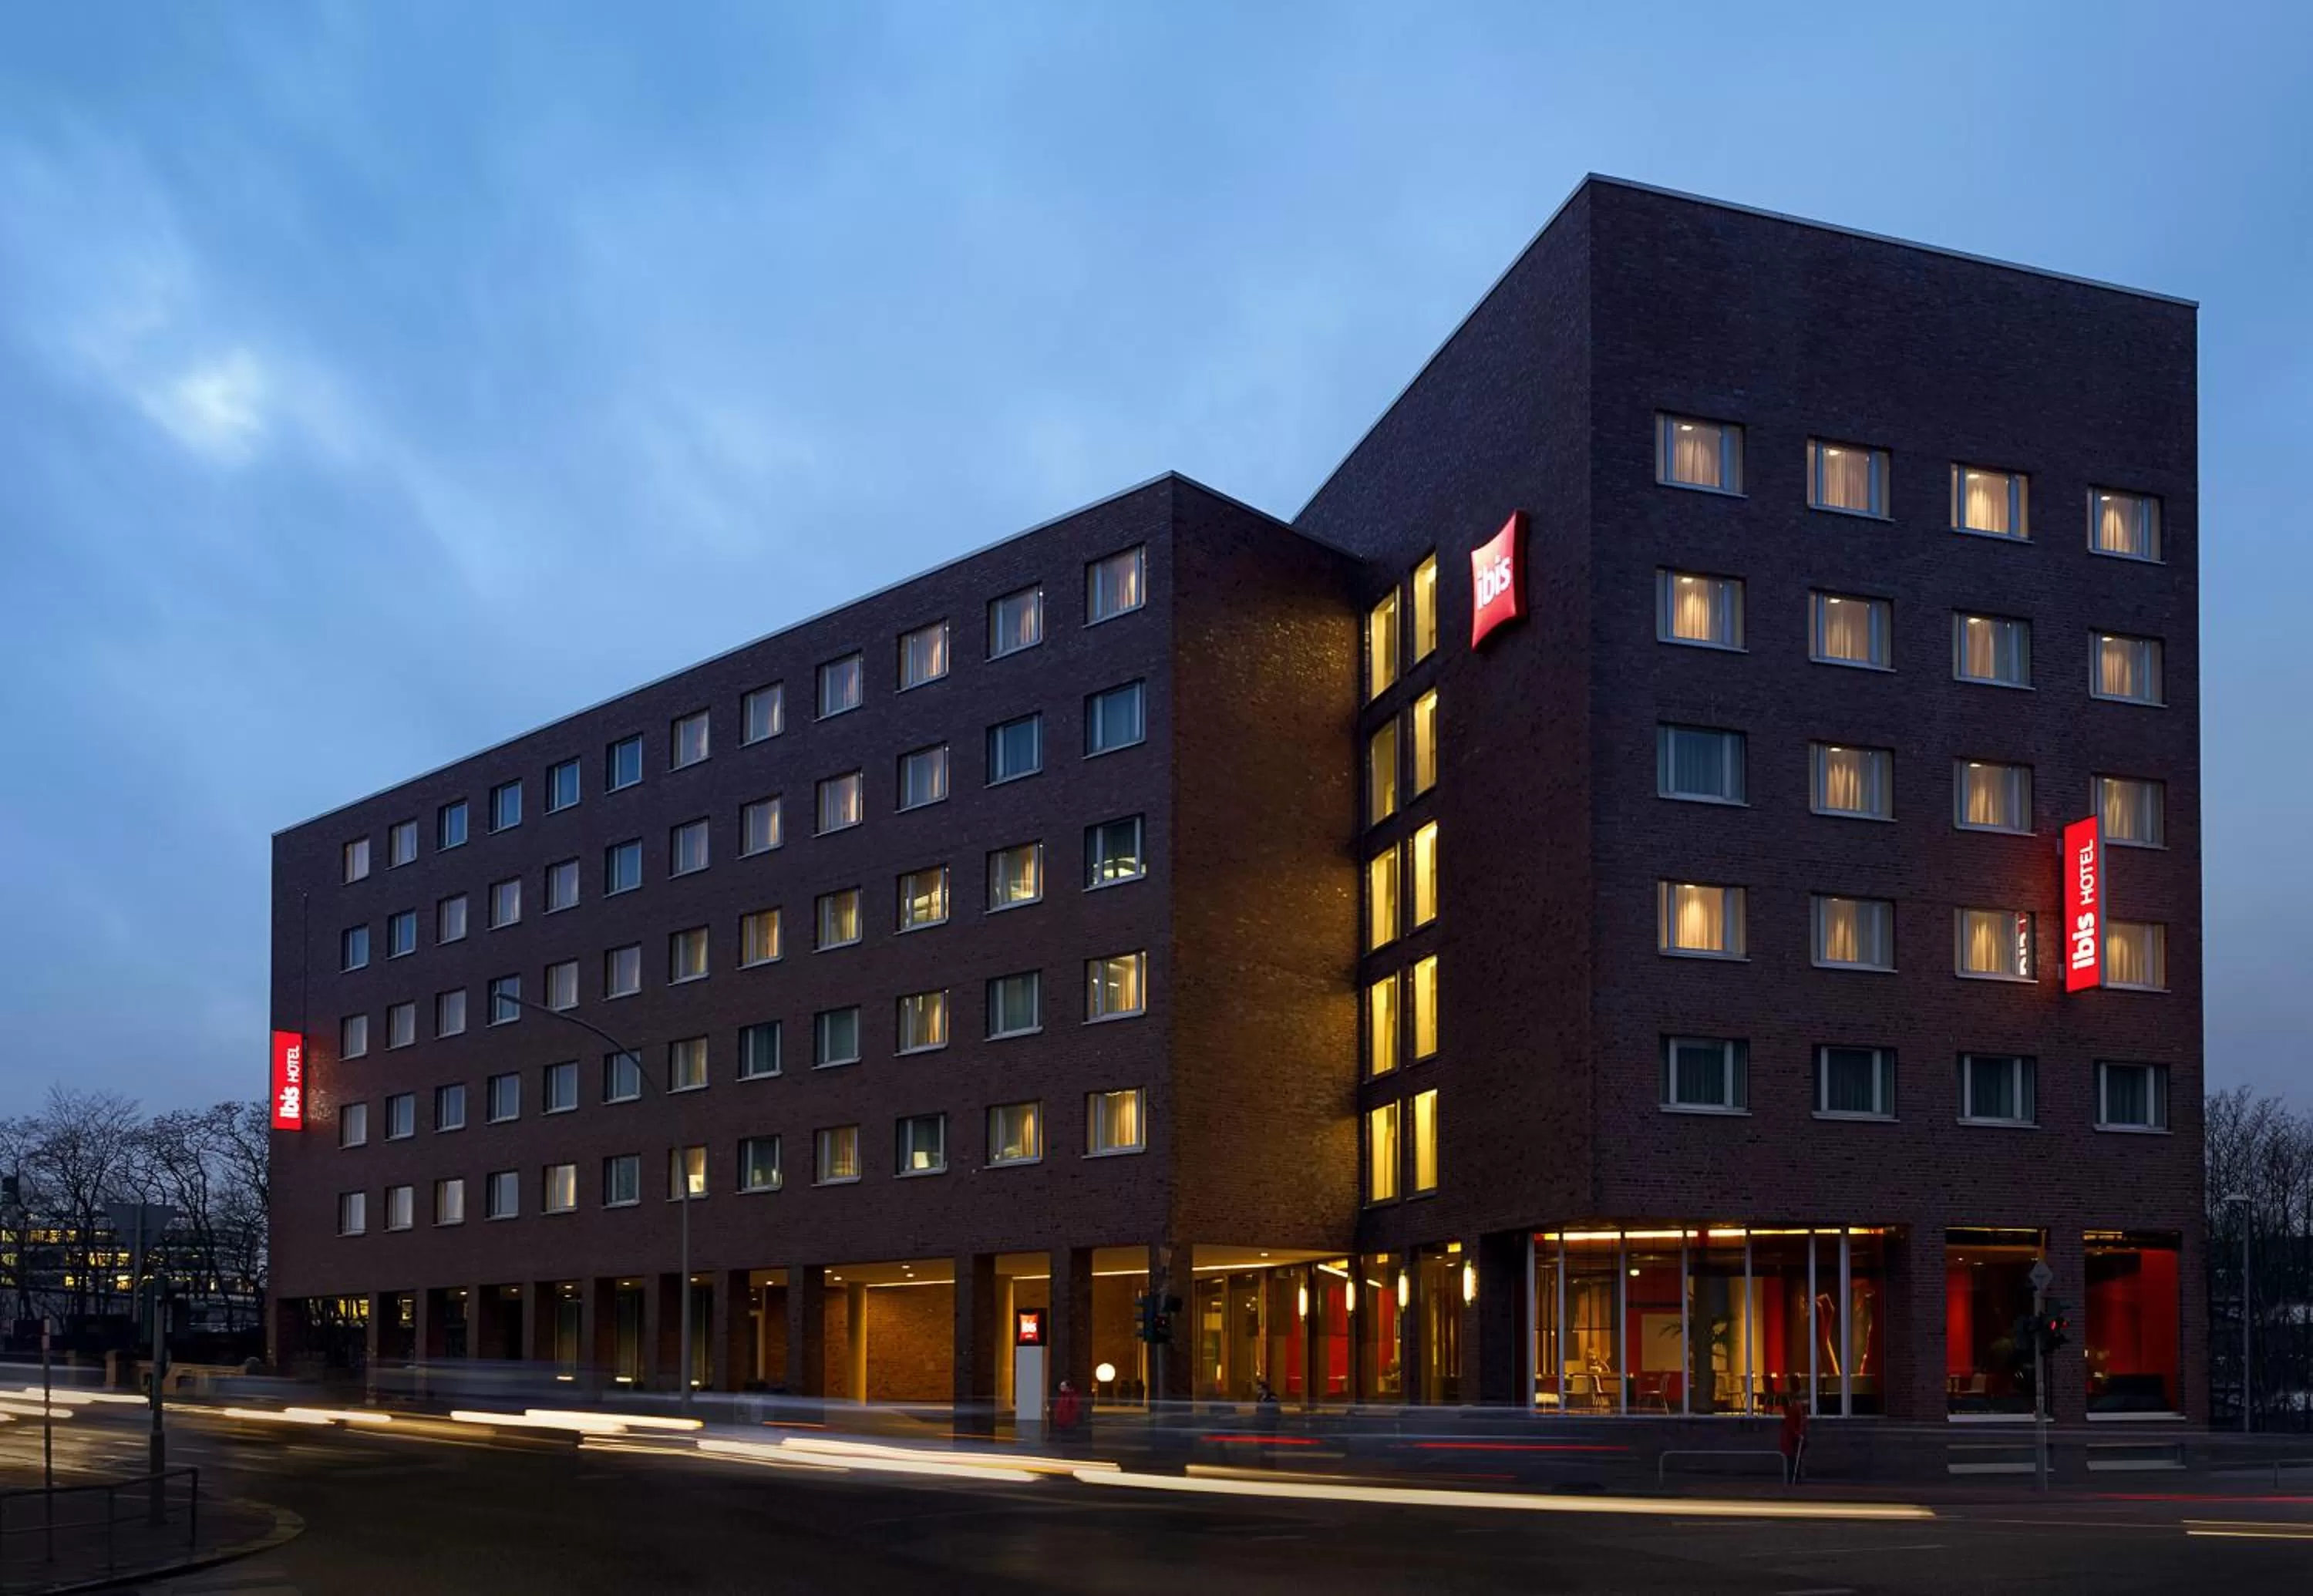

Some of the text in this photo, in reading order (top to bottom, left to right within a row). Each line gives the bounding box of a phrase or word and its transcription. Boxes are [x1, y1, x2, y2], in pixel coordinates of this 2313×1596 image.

[1476, 554, 1512, 611] ibis
[2072, 838, 2096, 970] ibis HOTEL
[279, 1045, 300, 1119] ibis HOTEL
